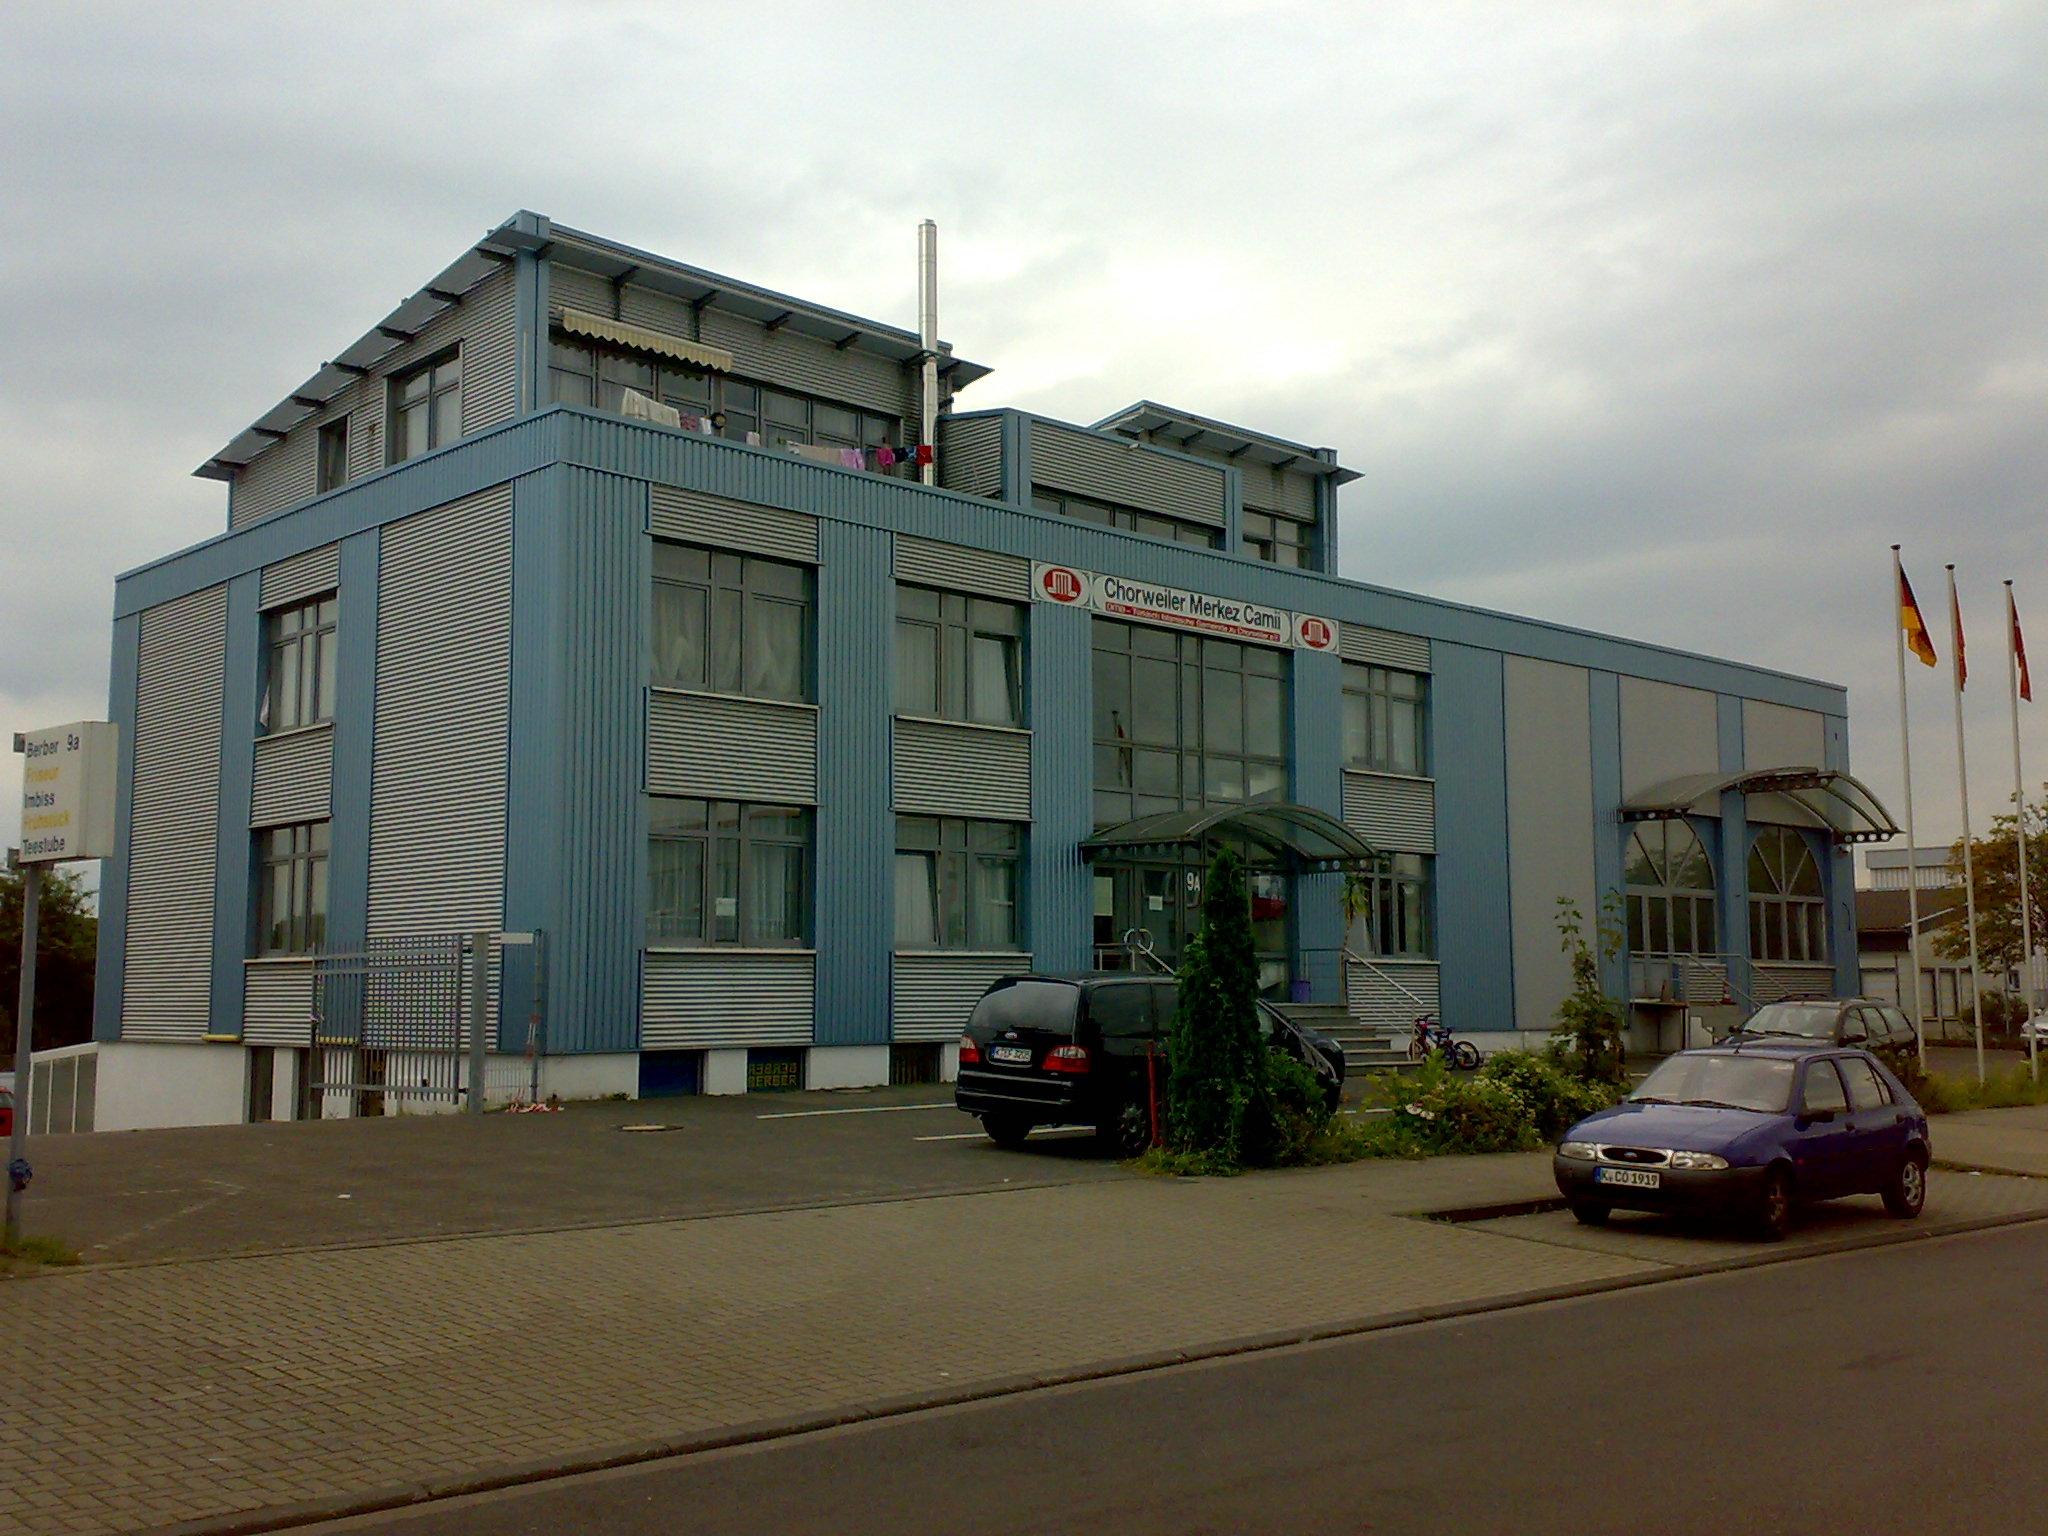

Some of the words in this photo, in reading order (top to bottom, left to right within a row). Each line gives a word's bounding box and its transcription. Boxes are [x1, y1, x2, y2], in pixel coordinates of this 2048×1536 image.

[1104, 577, 1186, 612] Chorweiler
[1189, 593, 1241, 623] Merkez
[1243, 605, 1281, 630] Camii
[26, 740, 60, 759] Berber
[66, 733, 80, 752] 9a
[23, 791, 56, 809] Imbiss
[22, 836, 66, 857] Teestube
[1186, 871, 1200, 891] 9A
[1631, 1172, 1658, 1186] 1919
